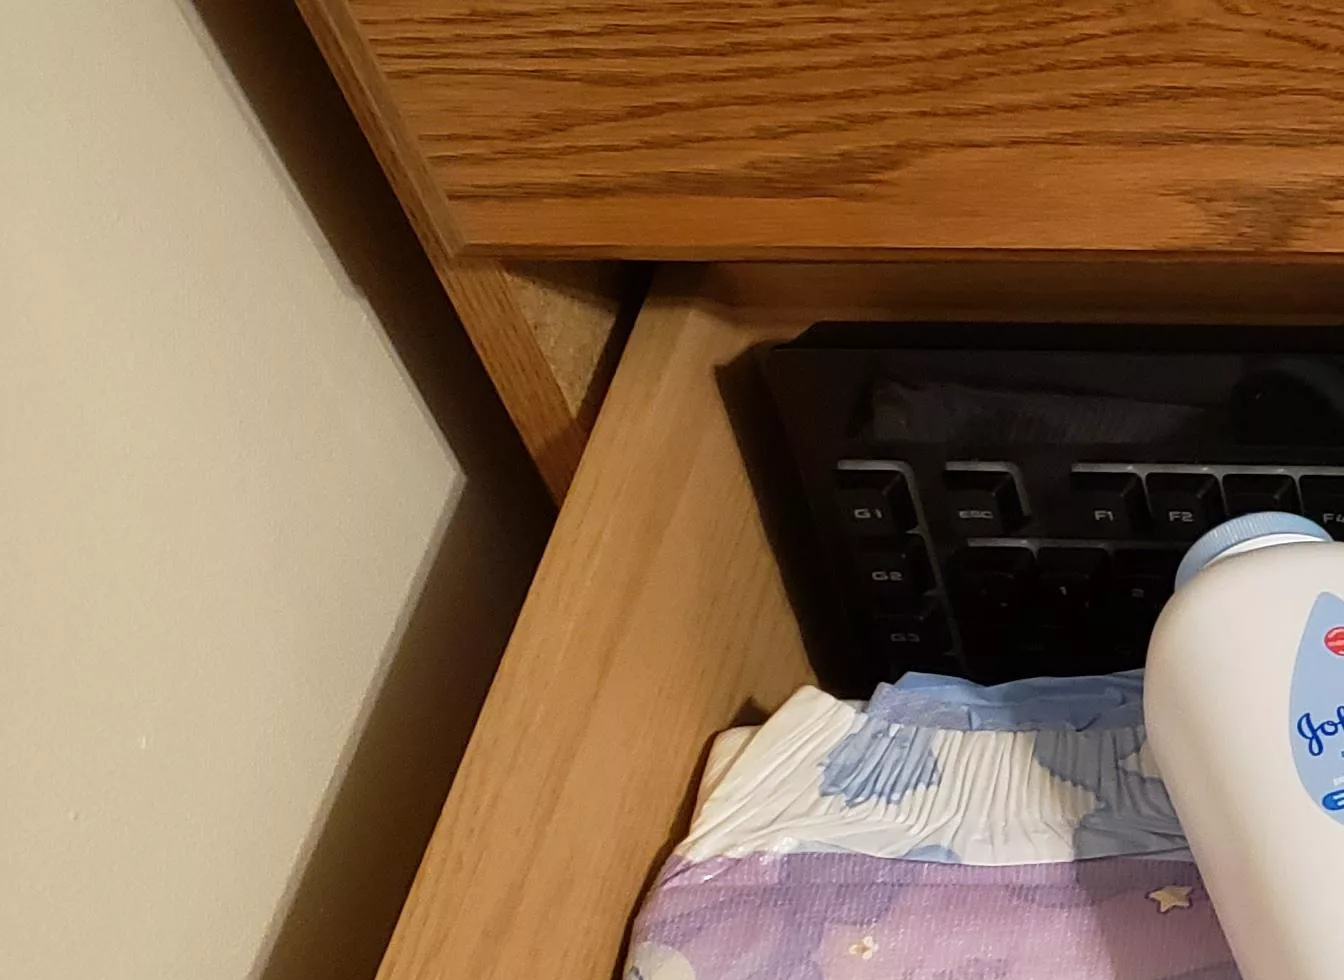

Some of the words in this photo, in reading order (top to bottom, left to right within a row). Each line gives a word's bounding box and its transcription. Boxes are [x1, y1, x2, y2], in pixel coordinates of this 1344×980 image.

[853, 507, 884, 520] G1
[1093, 508, 1116, 522] F1
[1168, 510, 1195, 524] F2
[871, 569, 904, 582] G2
[889, 632, 921, 643] G3
